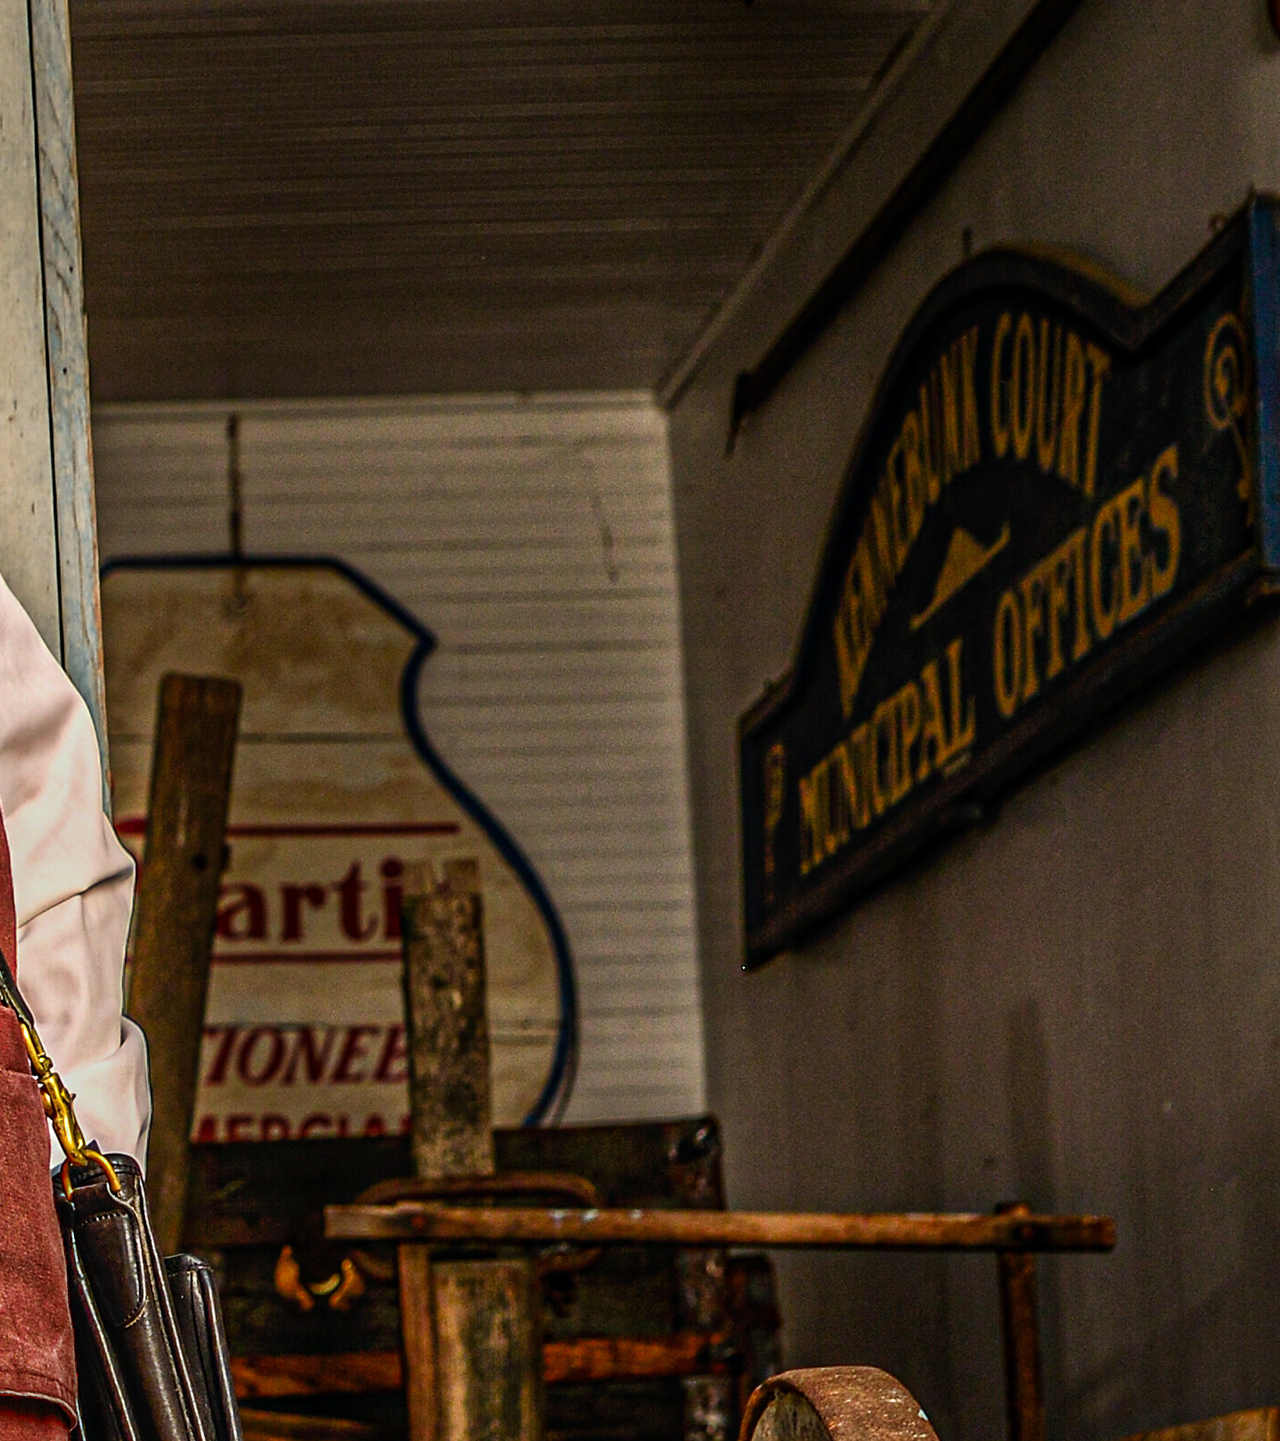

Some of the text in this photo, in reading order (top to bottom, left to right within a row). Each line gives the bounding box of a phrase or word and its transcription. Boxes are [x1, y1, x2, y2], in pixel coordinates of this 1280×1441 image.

[990, 311, 1111, 499] COURT
[798, 443, 1181, 876] MUNICIPAL OFFICES
[214, 858, 404, 943] arti
